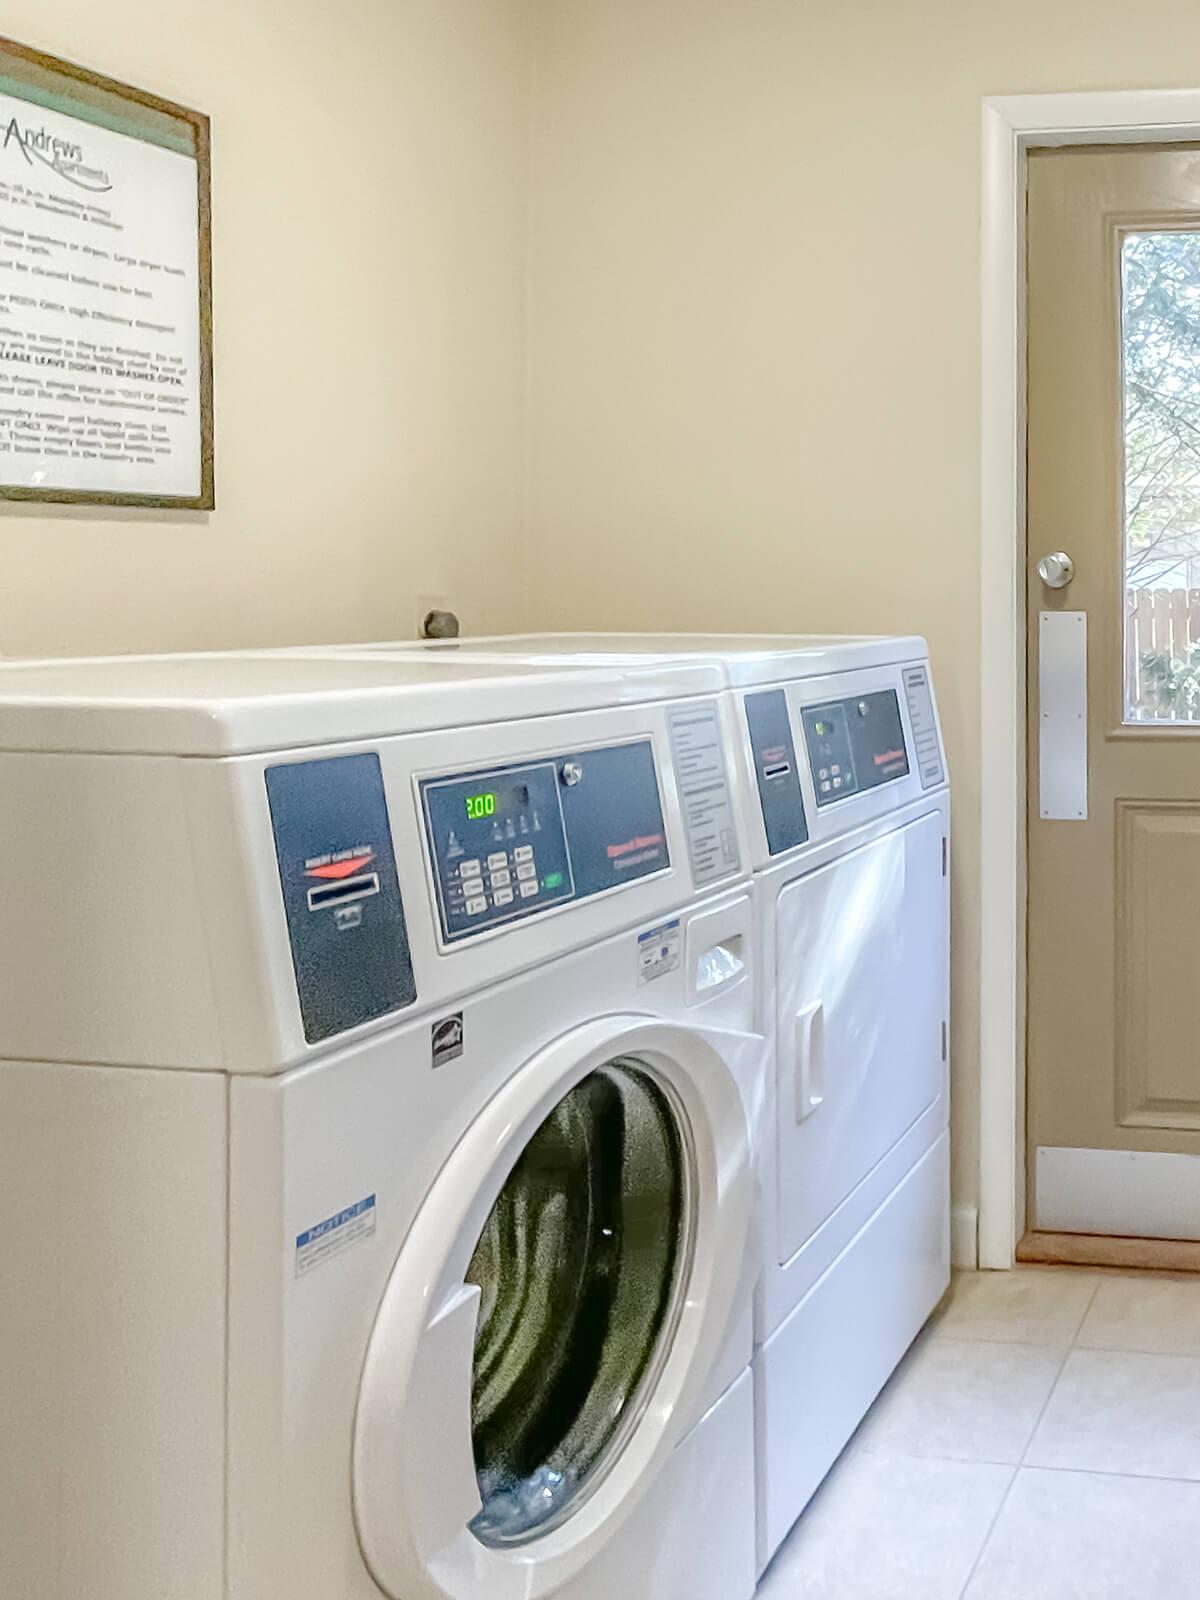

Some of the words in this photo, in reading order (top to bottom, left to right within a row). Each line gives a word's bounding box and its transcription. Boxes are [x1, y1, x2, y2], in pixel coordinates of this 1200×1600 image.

[3, 117, 82, 165] Andrews
[35, 356, 65, 370] LEAVE
[69, 361, 97, 374] DOOR
[101, 366, 112, 377] TO
[116, 368, 154, 383] WASHER
